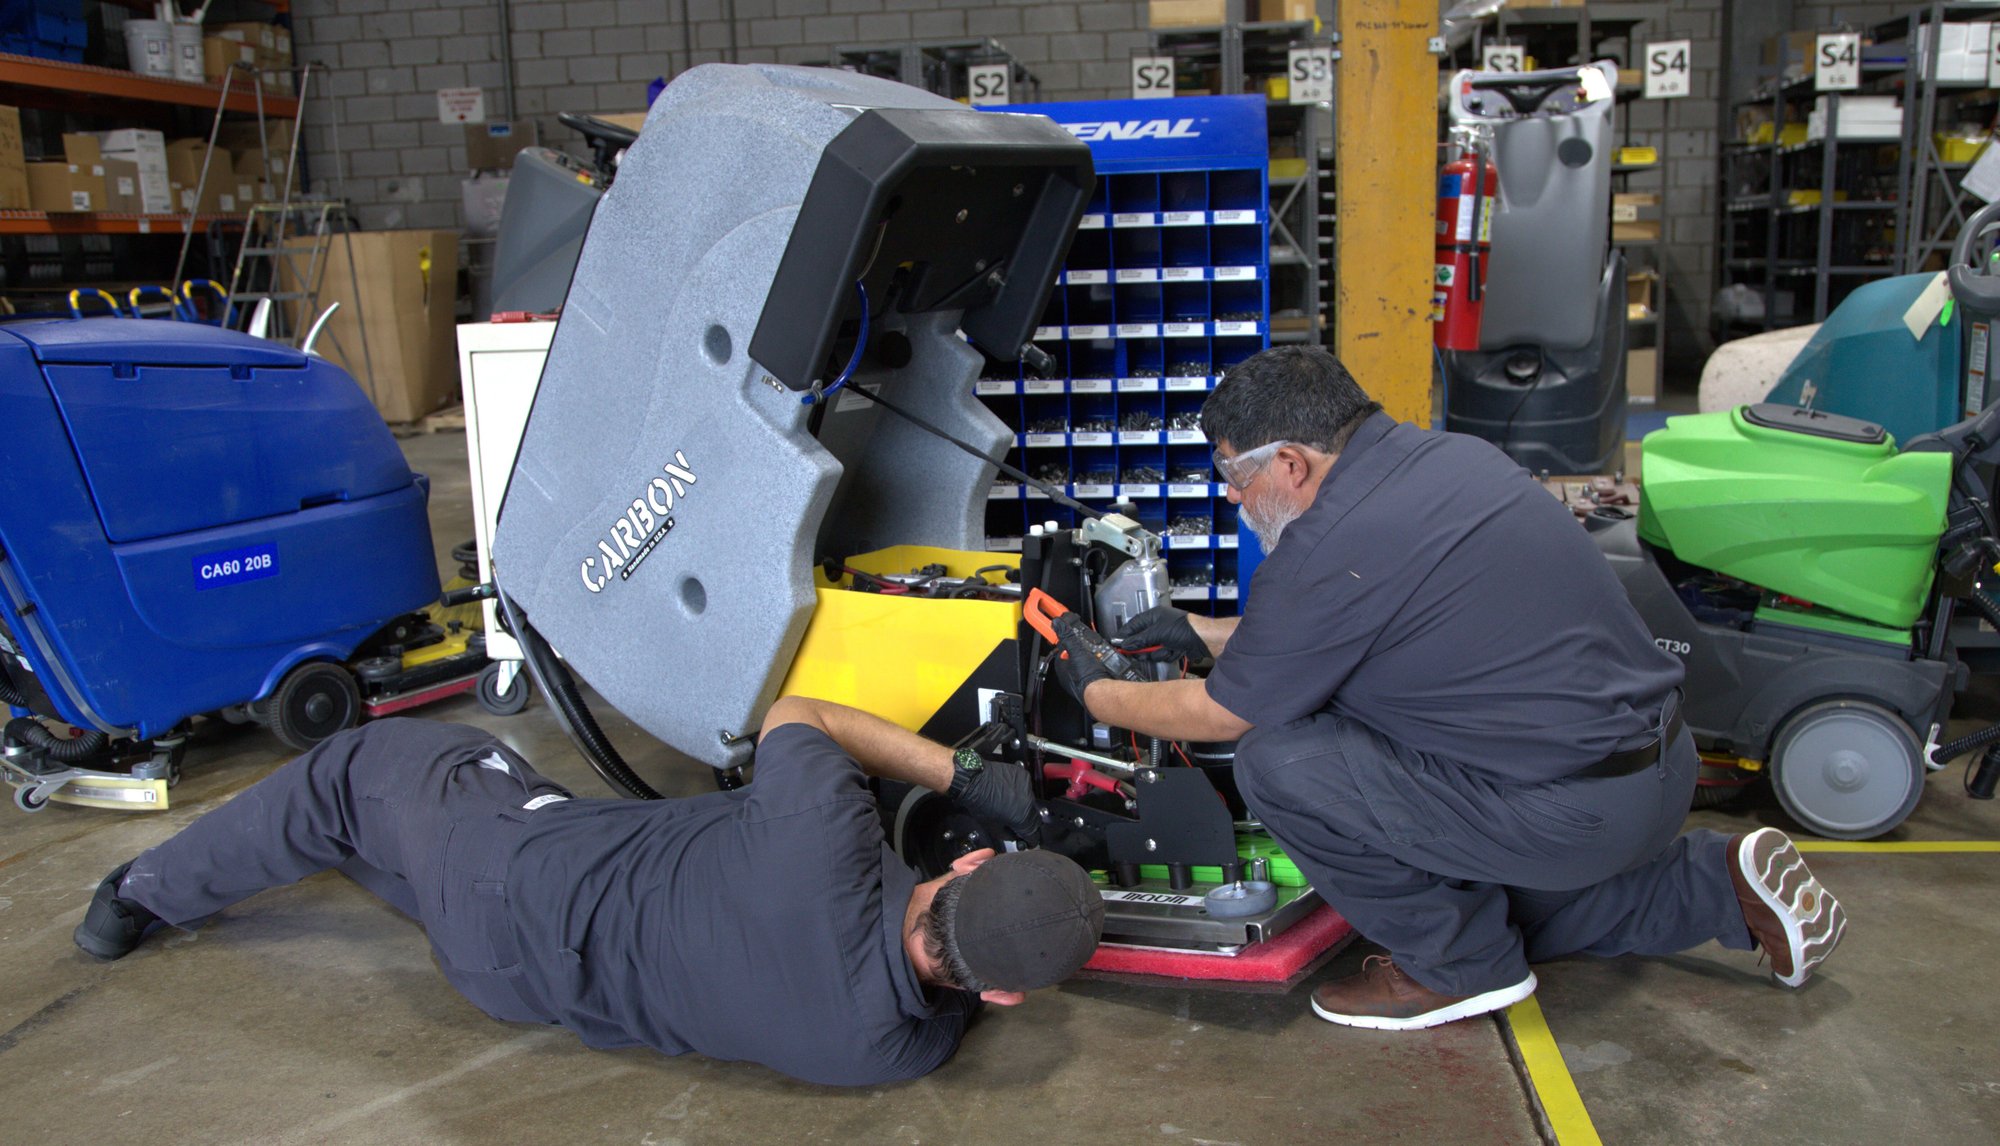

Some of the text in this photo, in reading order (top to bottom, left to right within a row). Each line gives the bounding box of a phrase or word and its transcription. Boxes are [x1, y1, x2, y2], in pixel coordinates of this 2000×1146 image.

[1651, 50, 1687, 75] S4
[1821, 43, 1856, 67] S4
[1137, 64, 1170, 90] S2
[1294, 56, 1326, 81] S3
[973, 72, 1005, 97] S2
[1058, 118, 1200, 141] ENAL
[581, 449, 697, 593] CARBON
[201, 554, 272, 579] CA60 20B
[627, 547, 650, 573] Handmade
[1654, 638, 1691, 654] CT30
